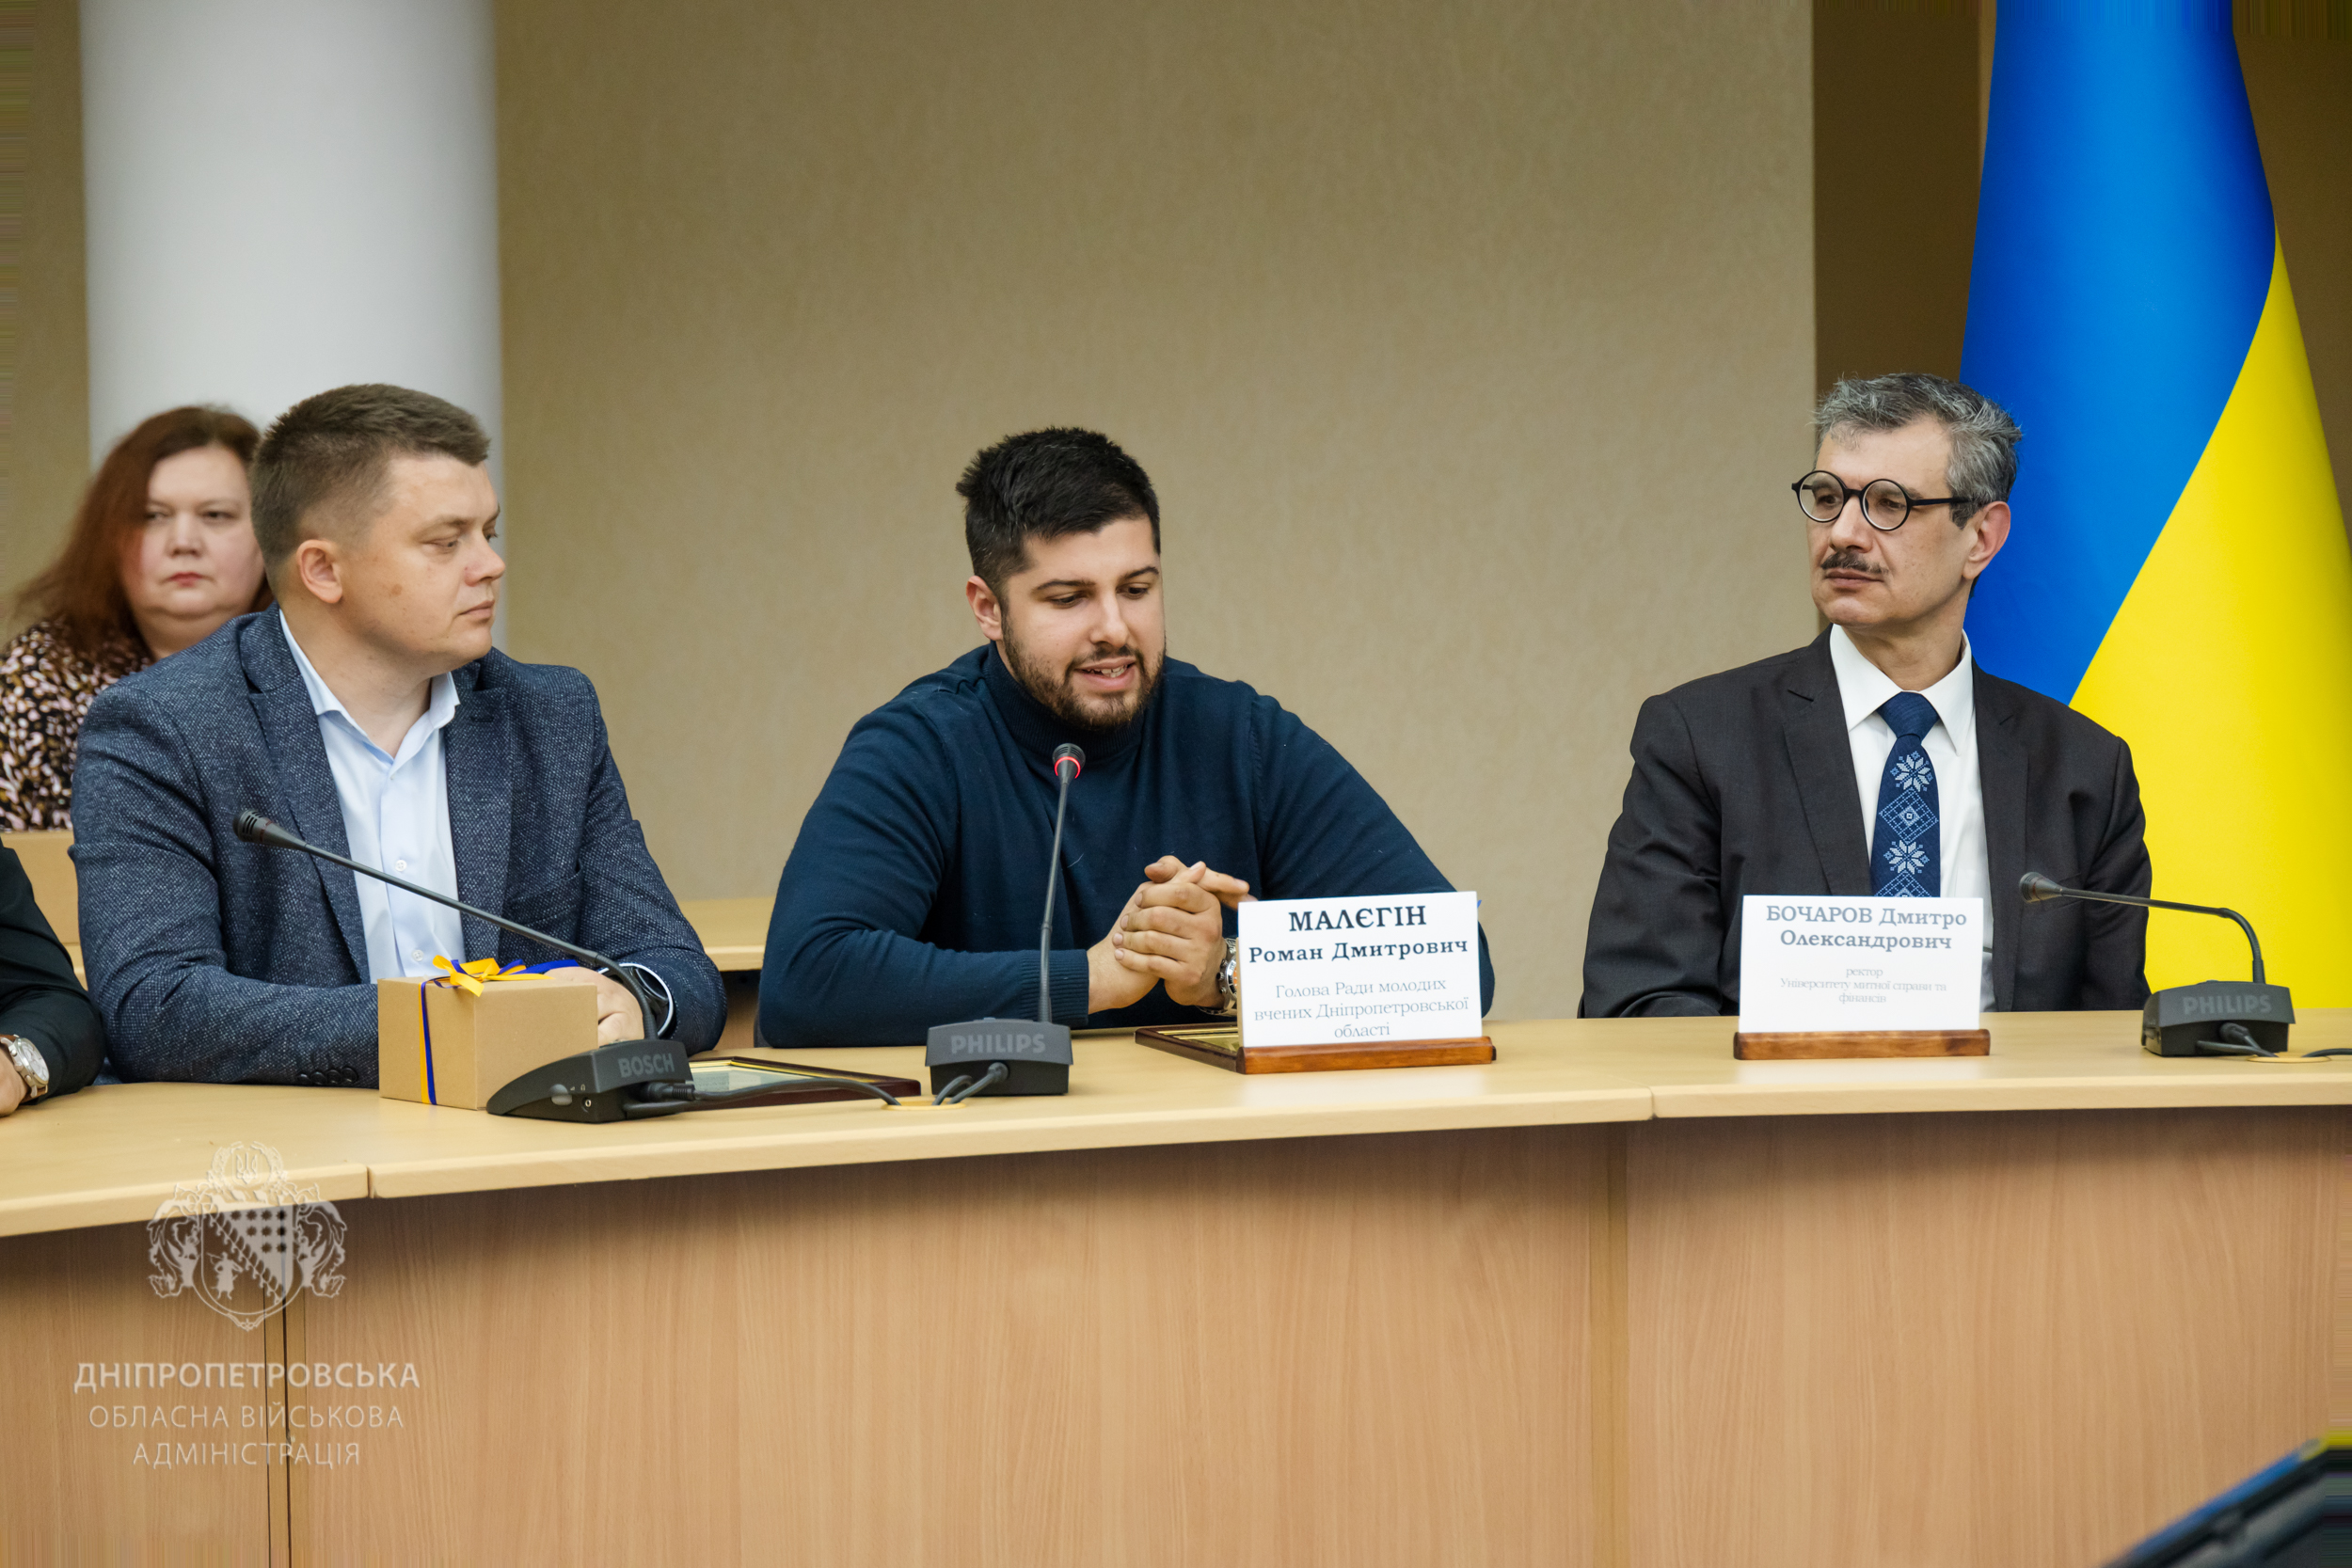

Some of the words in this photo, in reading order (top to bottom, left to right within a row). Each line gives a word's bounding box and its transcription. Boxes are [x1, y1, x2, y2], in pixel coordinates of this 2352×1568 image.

[1288, 905, 1426, 932] МАЛЄГІН
[1766, 905, 1873, 924] БОЧАРОВ
[1878, 908, 1967, 929] Дмитро
[1780, 929, 1952, 952] Олександрович
[1248, 946, 1324, 963] Роман
[1331, 941, 1469, 961] Дмитрович
[1845, 968, 1883, 978] ректор
[1276, 985, 1330, 998] Голова
[1335, 981, 1374, 996] Ради
[1378, 979, 1447, 993] молодих
[1780, 977, 1850, 990] Університету
[1852, 981, 1891, 991] митної
[1893, 982, 1931, 993] справи
[1934, 983, 1947, 991] та
[1838, 992, 1887, 1005] фінансів
[2183, 994, 2273, 1015] PHILIPS
[1254, 1008, 1312, 1022] вчених
[1315, 997, 1469, 1020] Дніпропетровської
[1334, 1022, 1391, 1038] області
[950, 1034, 1046, 1054] PHILIPS
[618, 1053, 675, 1079] BOSCH
